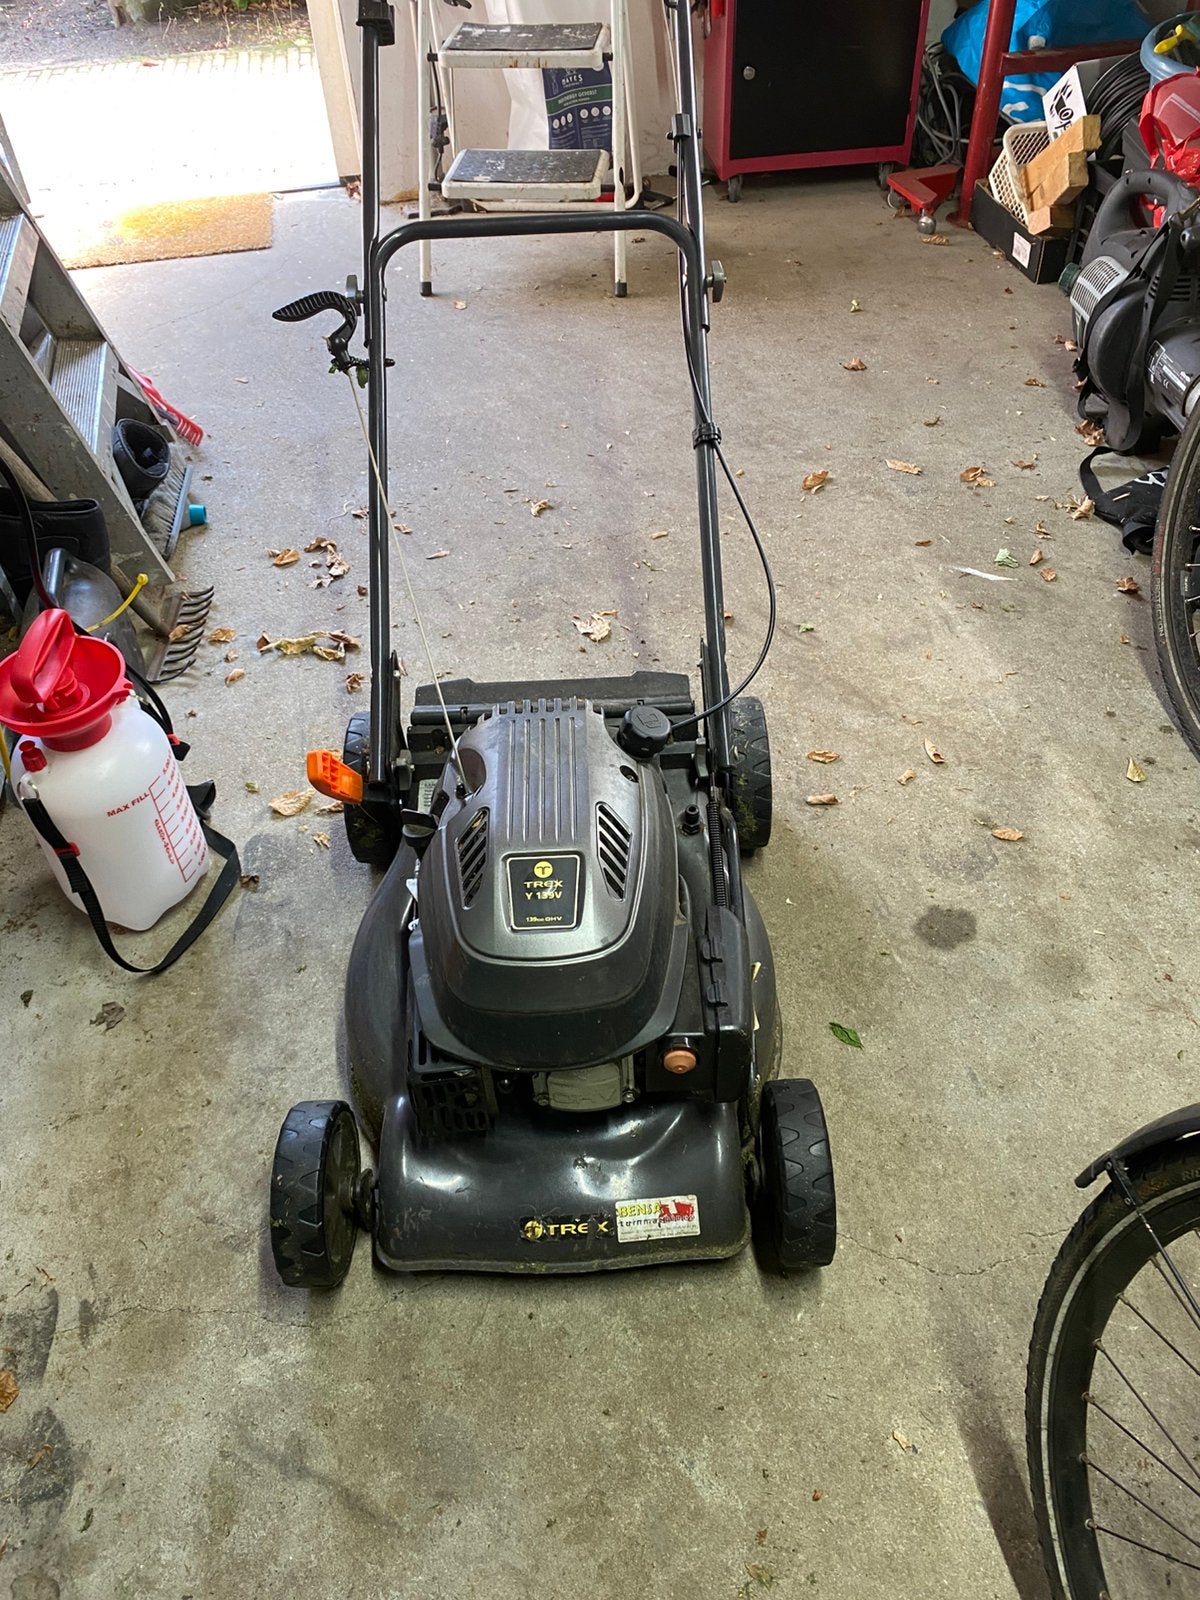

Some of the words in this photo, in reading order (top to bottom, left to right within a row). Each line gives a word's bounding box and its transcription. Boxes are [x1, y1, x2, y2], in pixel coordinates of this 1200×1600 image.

[107, 803, 130, 817] MAX
[131, 792, 150, 807] FILL
[523, 880, 563, 888] TREX
[525, 891, 533, 900] Y
[536, 891, 563, 900] 139V
